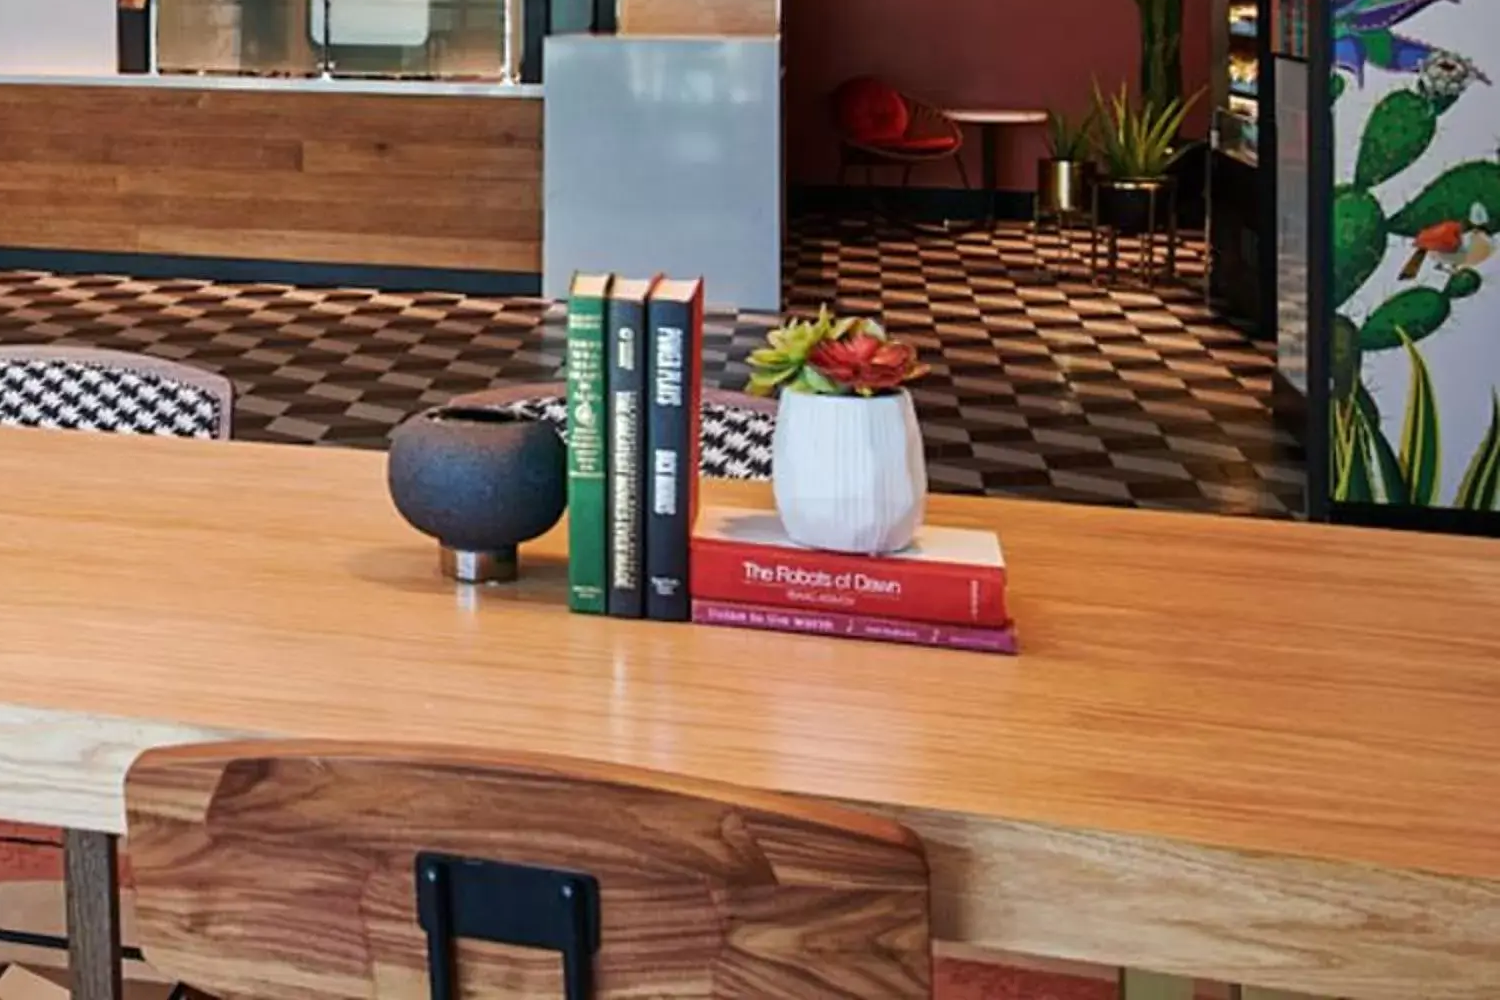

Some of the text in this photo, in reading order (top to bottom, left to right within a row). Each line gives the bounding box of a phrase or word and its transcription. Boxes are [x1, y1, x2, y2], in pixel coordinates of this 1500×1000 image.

[742, 560, 902, 594] The Robots of Dawn
